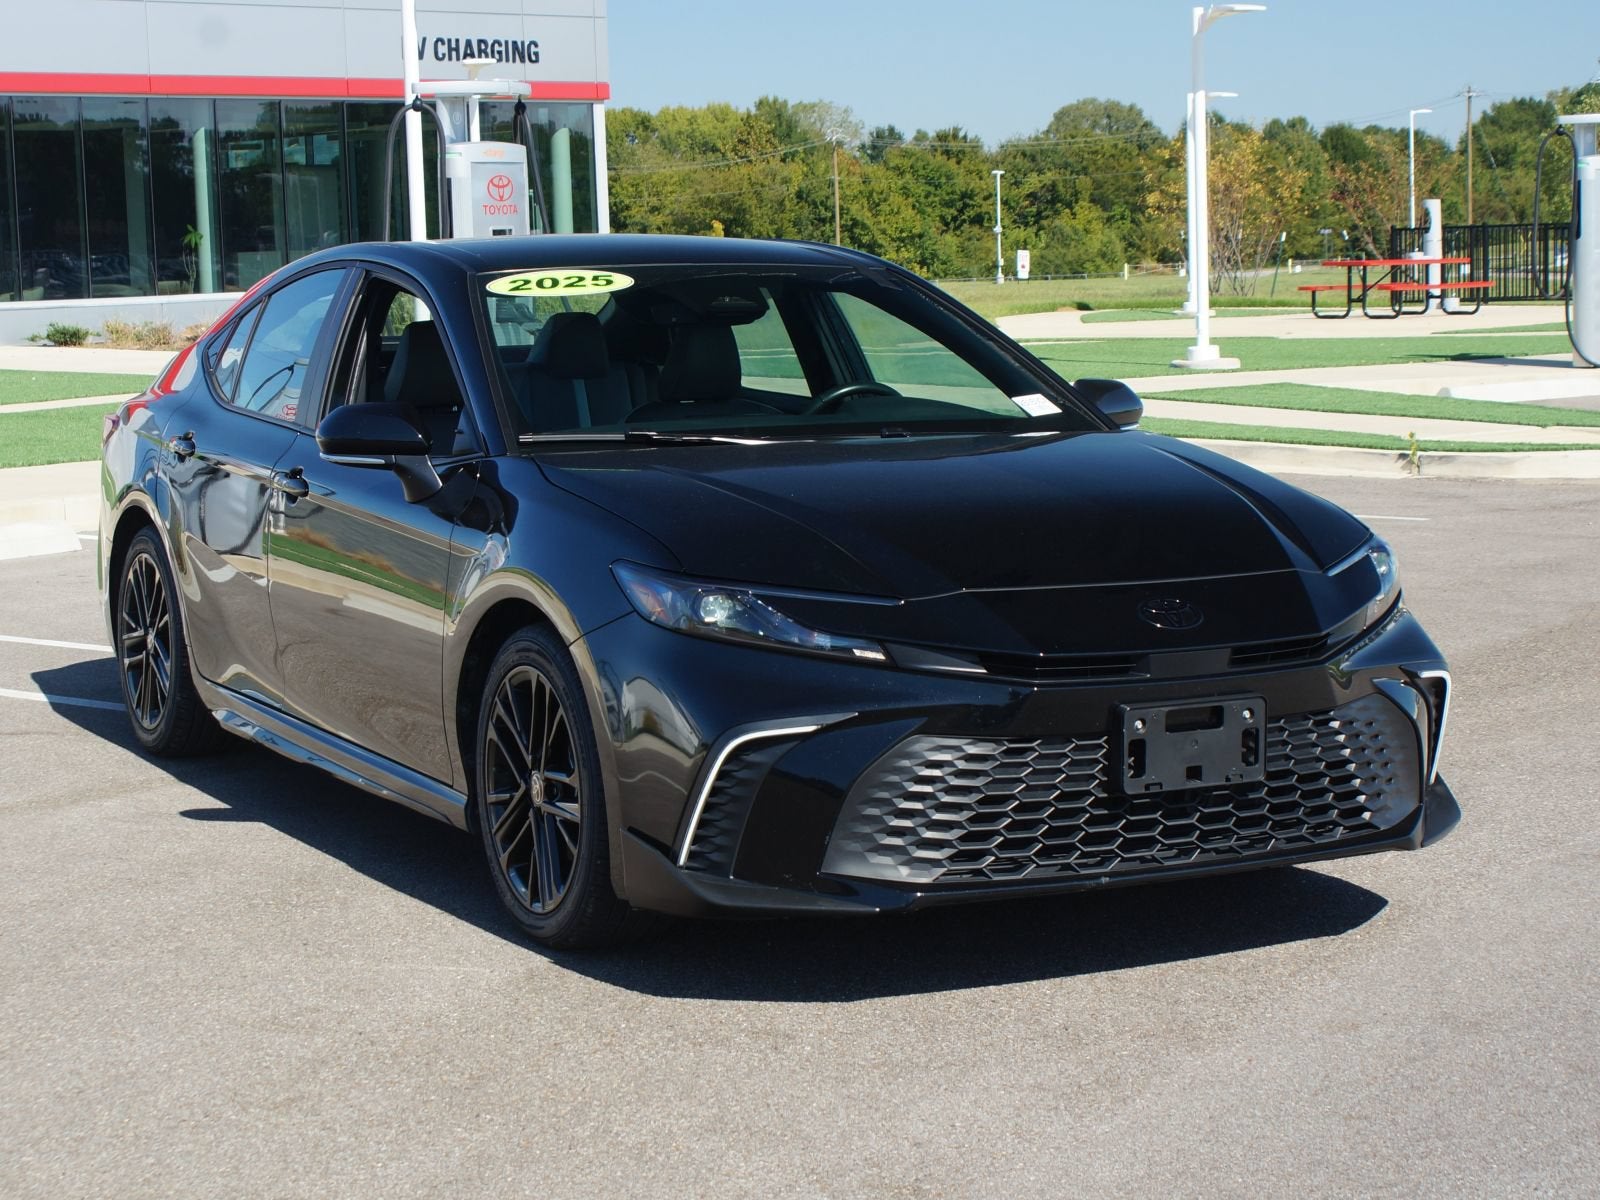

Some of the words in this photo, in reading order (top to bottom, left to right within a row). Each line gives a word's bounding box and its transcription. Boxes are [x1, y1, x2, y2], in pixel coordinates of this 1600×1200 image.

[433, 37, 540, 64] CHARGING
[482, 204, 518, 216] TOYOTA
[508, 274, 614, 292] 2025
